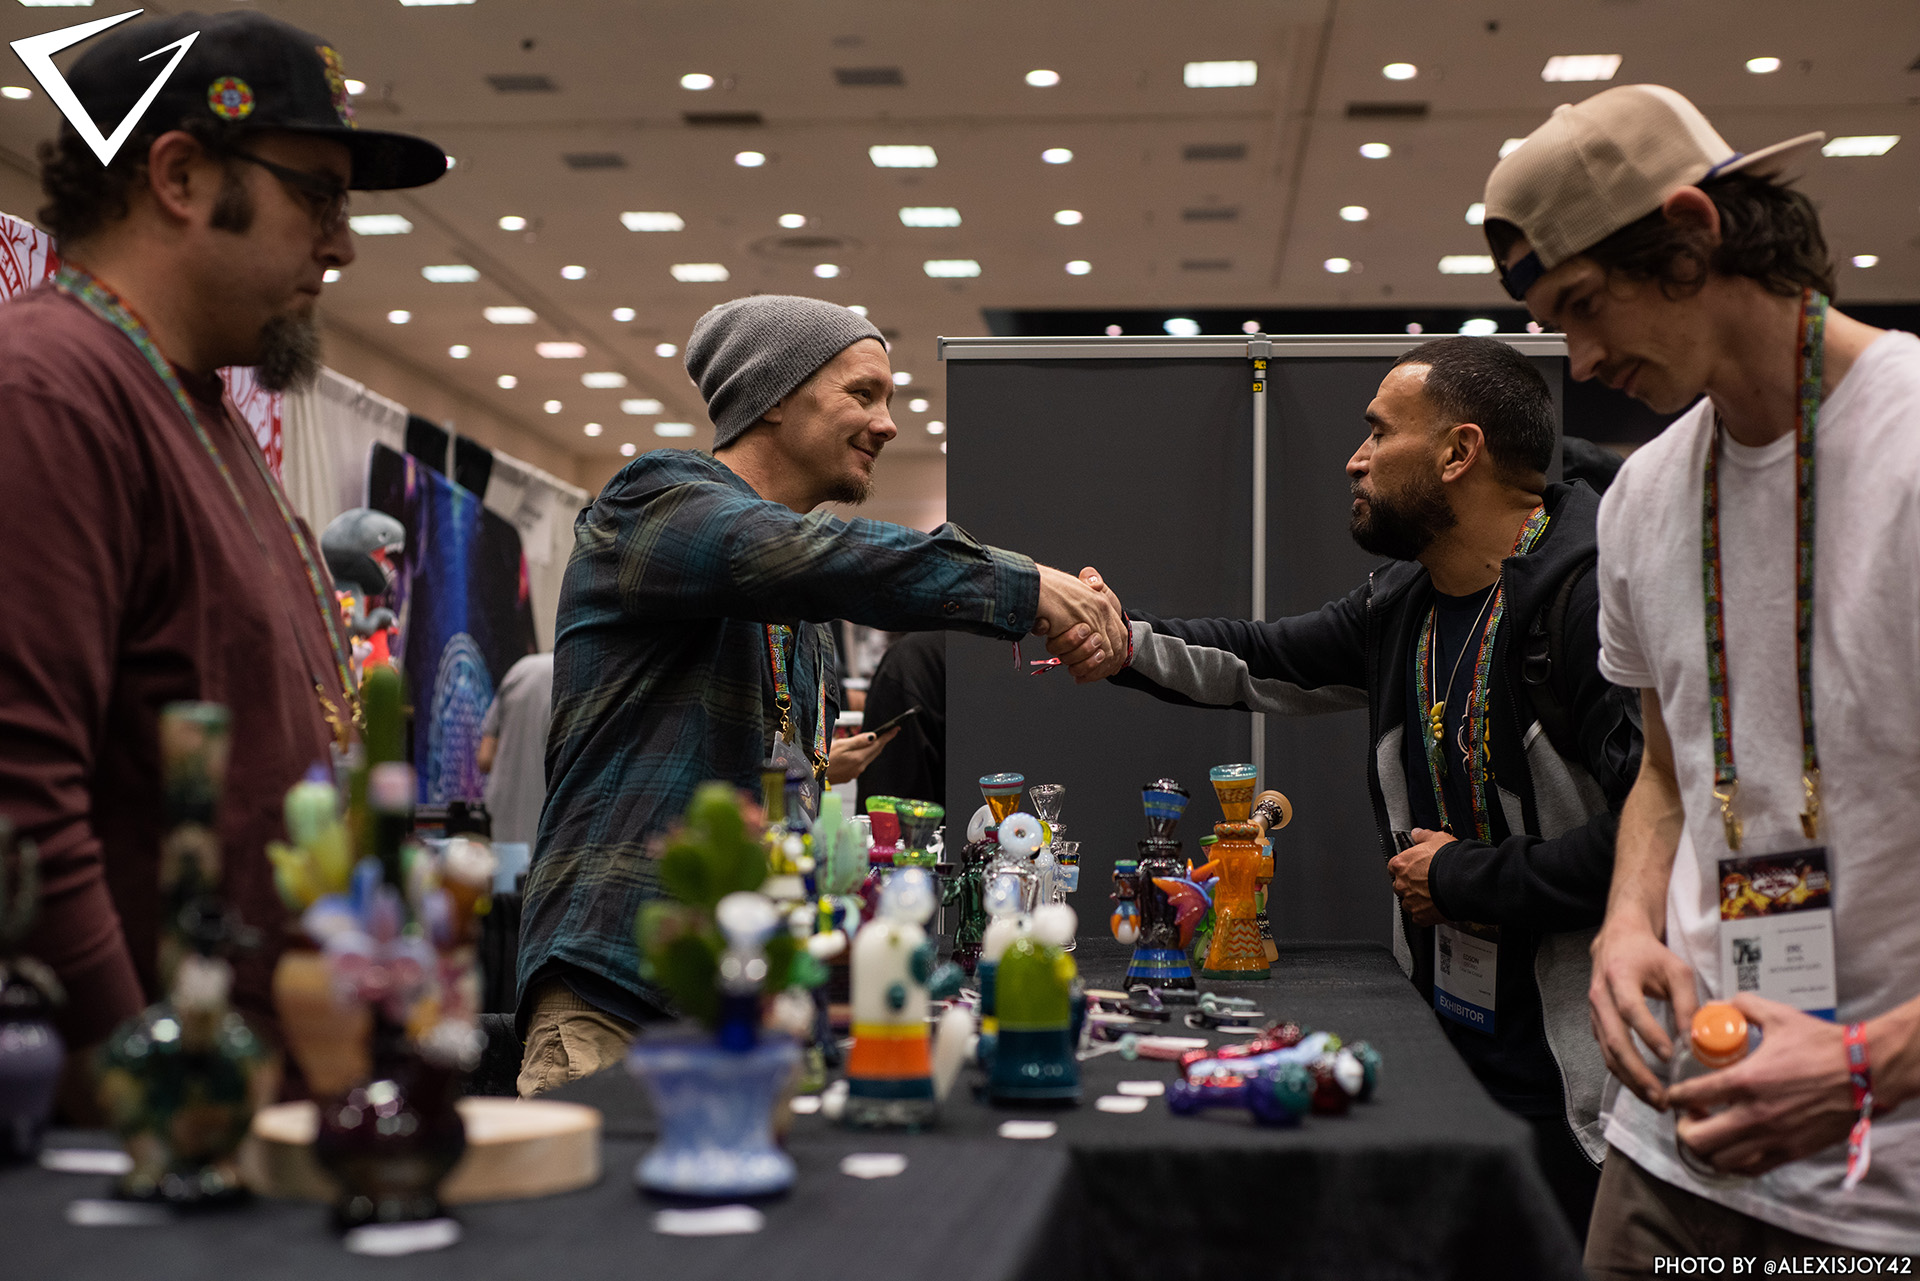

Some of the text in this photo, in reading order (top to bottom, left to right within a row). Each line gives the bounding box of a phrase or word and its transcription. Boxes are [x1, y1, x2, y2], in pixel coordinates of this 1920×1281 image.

[772, 648, 781, 670] mood
[1475, 680, 1483, 703] mood
[1716, 702, 1727, 732] mood
[1473, 784, 1482, 808] mood
[1439, 995, 1485, 1024] EXHIBITOR
